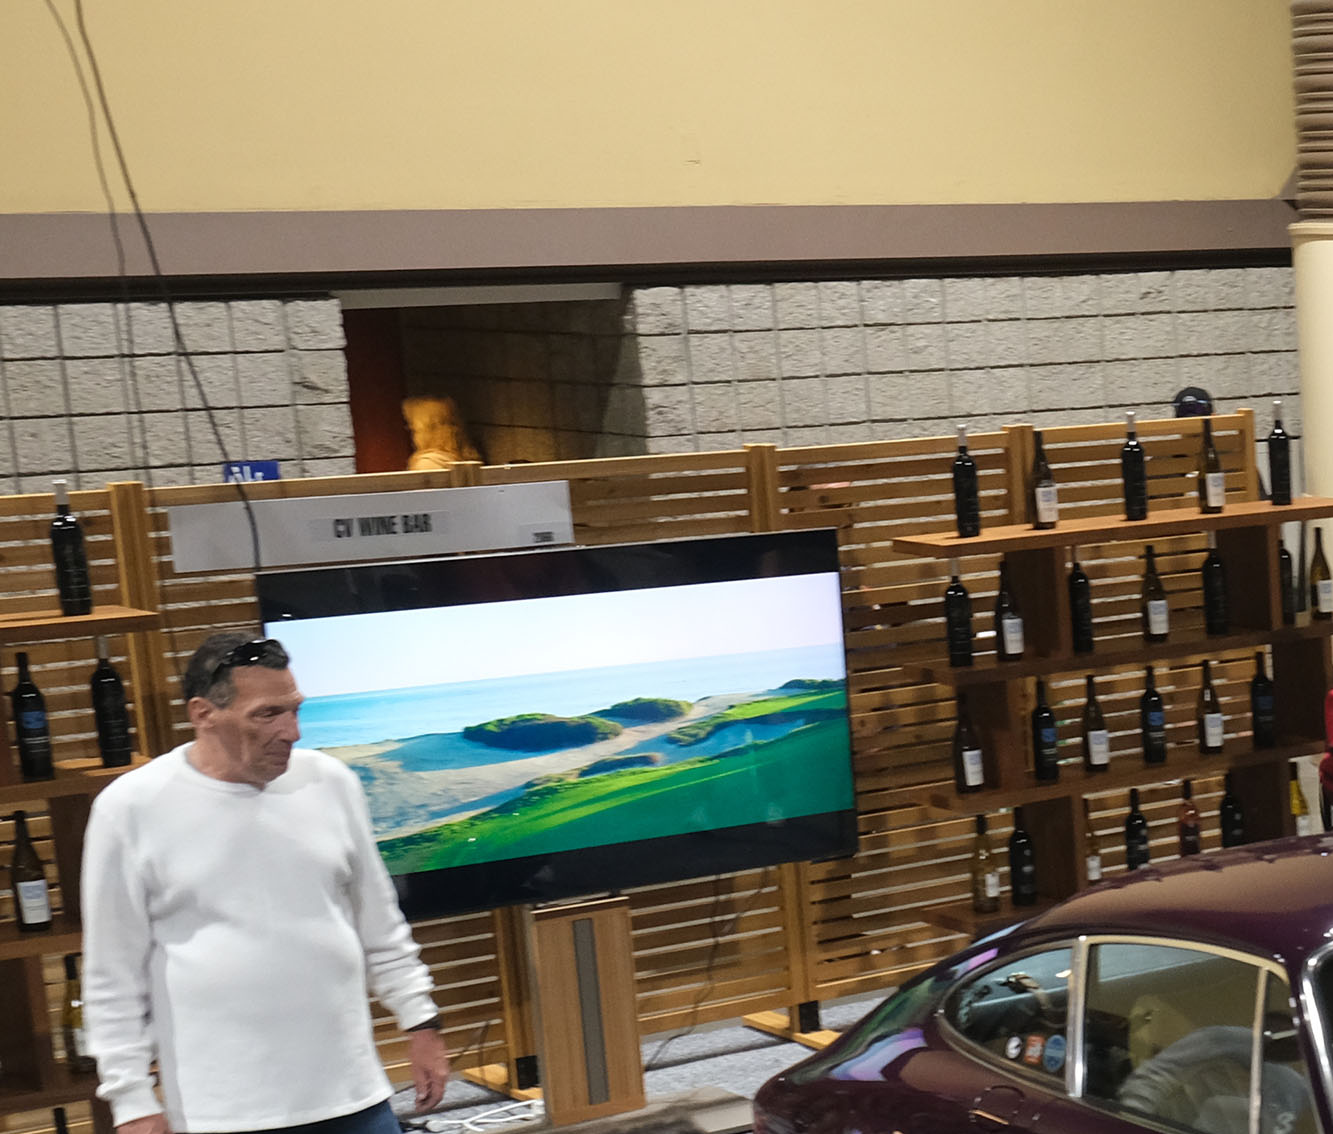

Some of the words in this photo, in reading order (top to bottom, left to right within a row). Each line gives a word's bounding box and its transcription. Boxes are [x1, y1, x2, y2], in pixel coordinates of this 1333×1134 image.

[333, 518, 354, 538] CV
[358, 515, 397, 536] WINE
[401, 513, 433, 534] BAR
